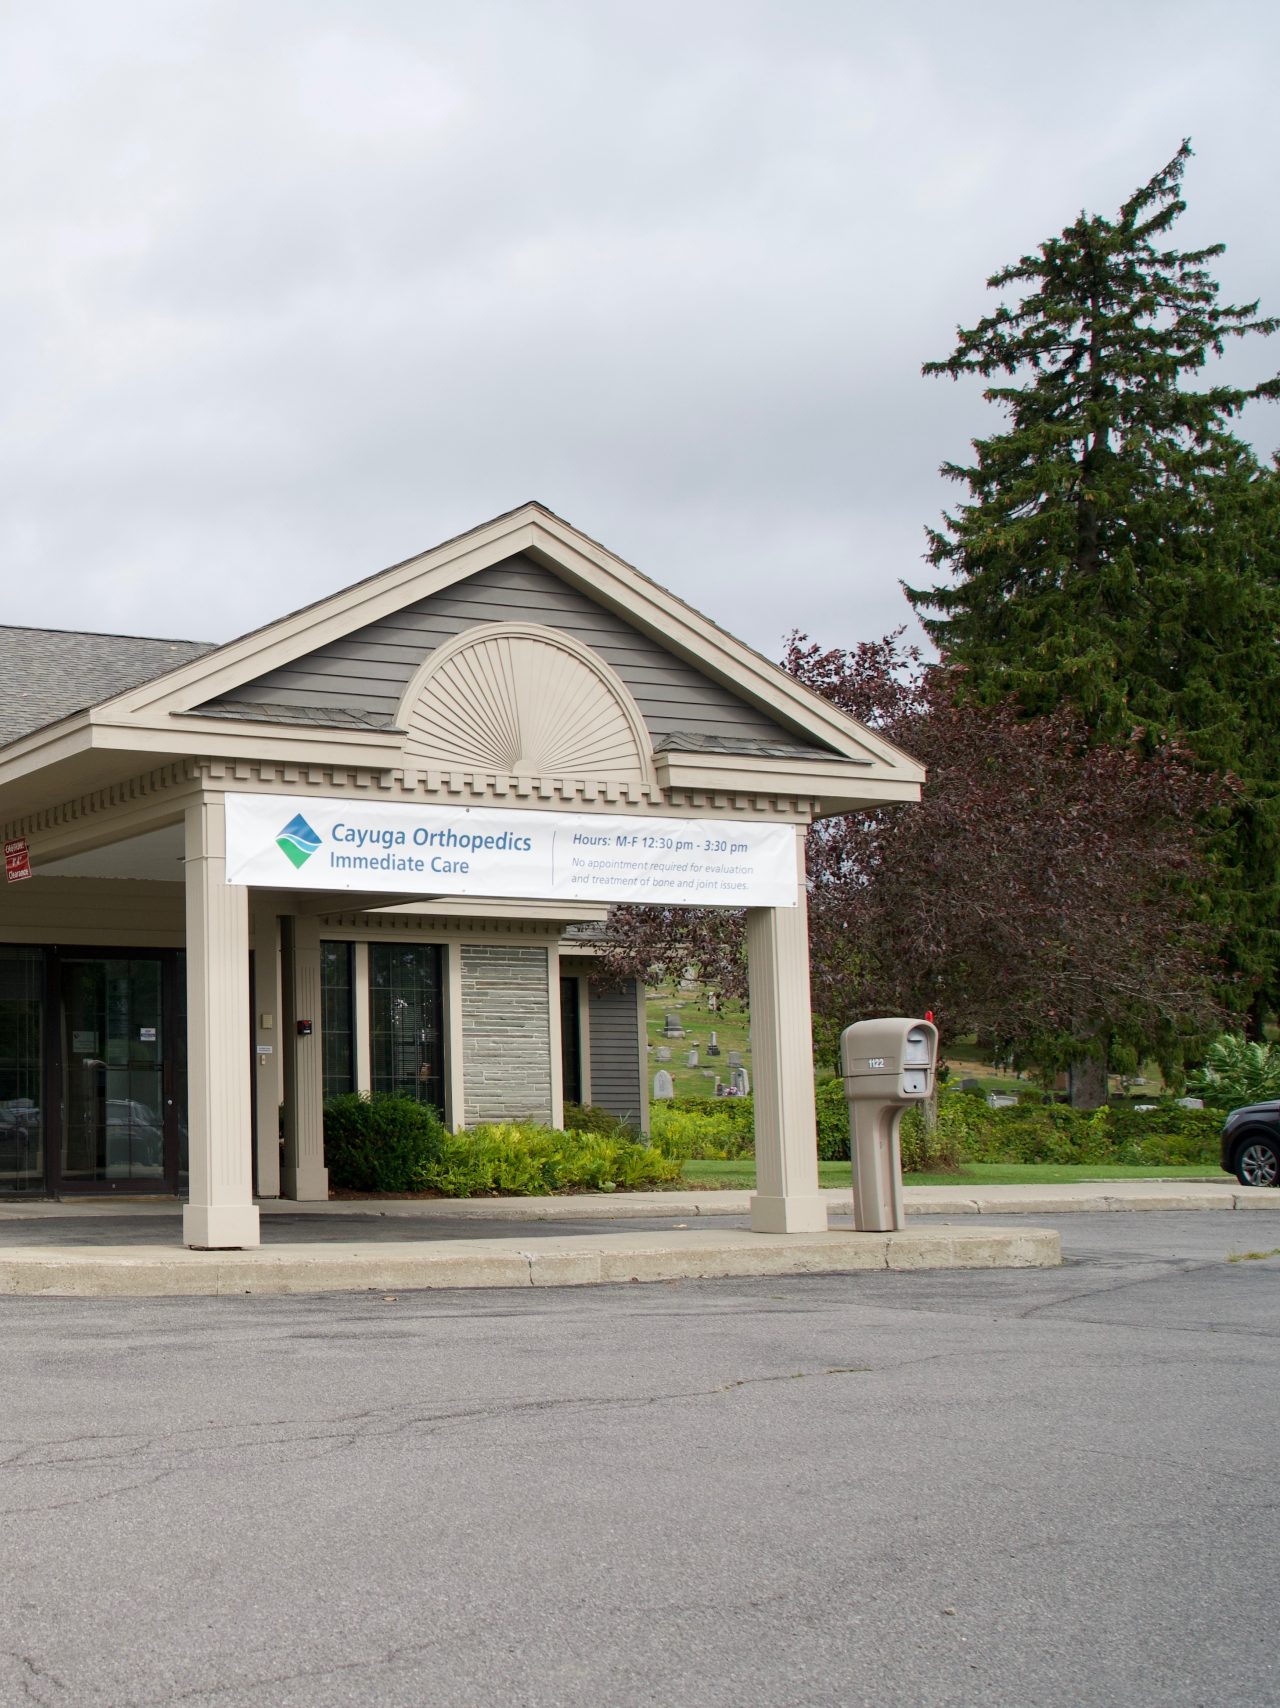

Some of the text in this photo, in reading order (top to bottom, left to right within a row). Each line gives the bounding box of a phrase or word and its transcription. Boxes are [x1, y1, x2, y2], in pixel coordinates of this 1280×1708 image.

[331, 823, 532, 853] Cayuga Orthopedics
[572, 833, 611, 846] Hours:
[616, 835, 639, 847] M-F
[642, 837, 673, 849] 12:30
[676, 841, 693, 852] pm
[703, 840, 727, 852] 3:30
[730, 843, 748, 855] pm
[330, 851, 470, 874] Immediate Care
[572, 857, 754, 874] No appointment required for evaluation
[571, 873, 749, 890] and treatment of bone and joint issues.
[868, 1058, 885, 1067] 1122
